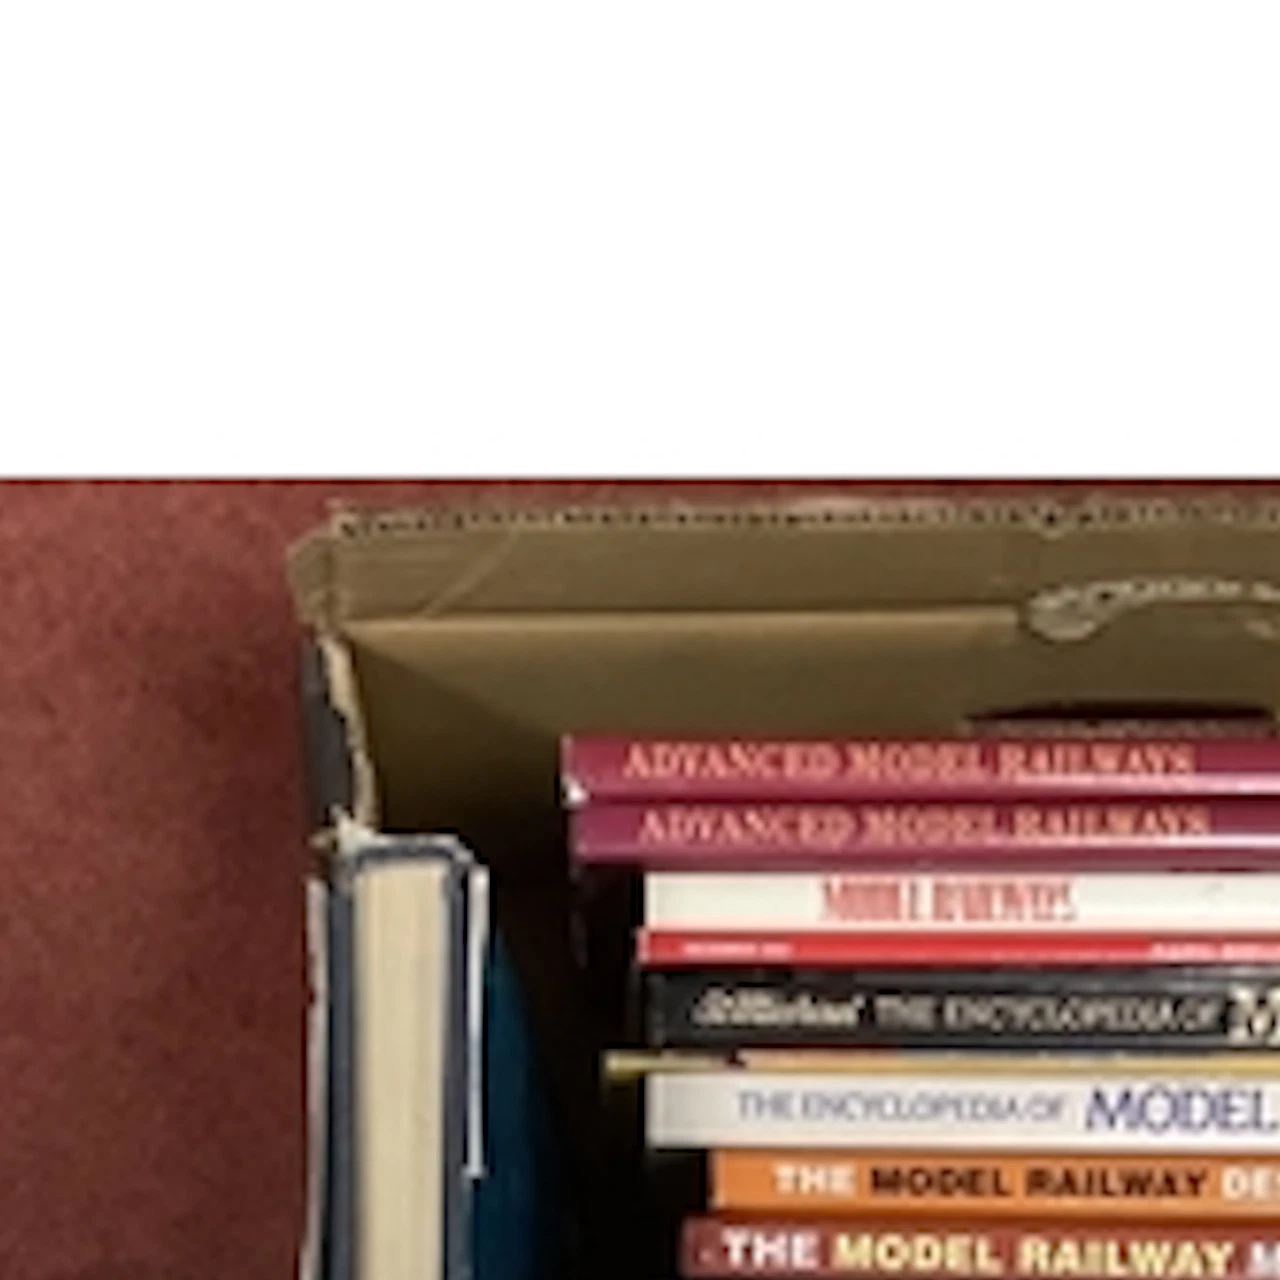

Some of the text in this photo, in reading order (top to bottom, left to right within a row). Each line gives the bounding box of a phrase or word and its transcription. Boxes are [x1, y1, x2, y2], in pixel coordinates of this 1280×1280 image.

[623, 742, 1195, 780] ADVANCED MODEL RAILWAYS
[637, 805, 1211, 845] ADVANCED MODEL RAILWAYS
[875, 997, 933, 1031] THE
[736, 1092, 795, 1121] THE
[801, 1092, 1023, 1122] ENCYCLOPEDIA
[1027, 1093, 1064, 1121] OF
[1084, 1086, 1280, 1133] MODEL
[775, 1165, 856, 1195] THE
[870, 1167, 1009, 1197] MODEL
[1026, 1167, 1207, 1198] RAILWAY
[721, 1229, 819, 1268] THE
[833, 1233, 1005, 1273] MODEL
[1018, 1238, 1233, 1277] RAILWAY
